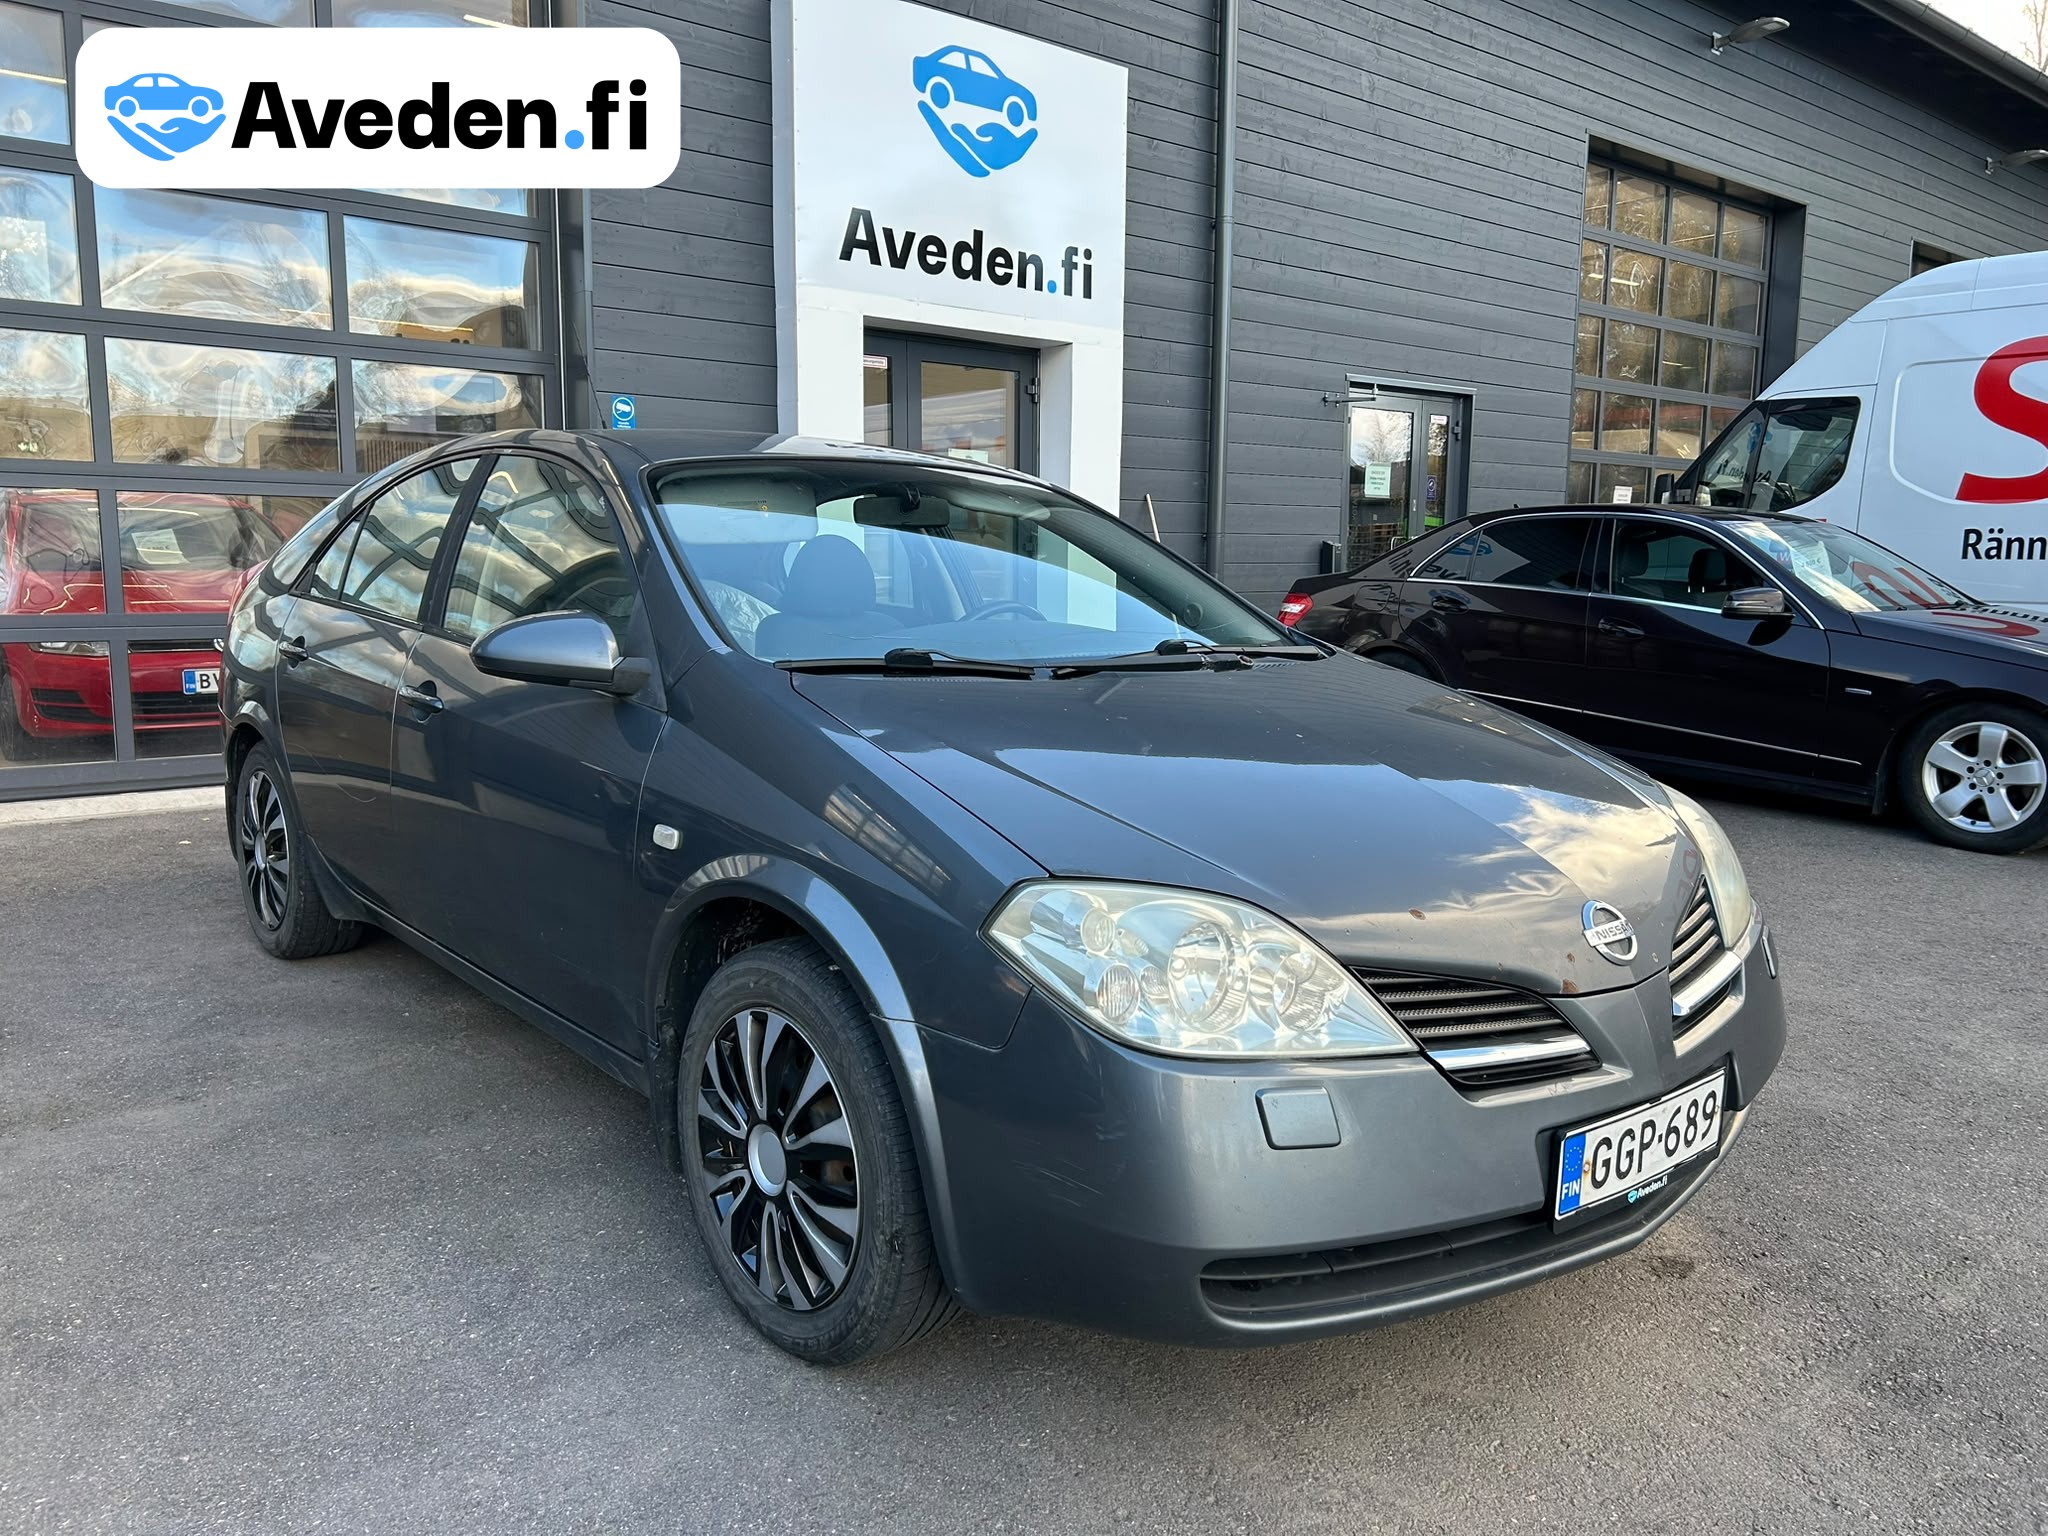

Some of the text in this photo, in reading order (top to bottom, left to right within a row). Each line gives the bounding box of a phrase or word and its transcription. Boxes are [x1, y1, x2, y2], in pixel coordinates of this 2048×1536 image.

[838, 206, 1093, 300] Aveden.fi
[1954, 335, 2048, 504] S
[1590, 1089, 1718, 1190] GGP-689
[1637, 1174, 1668, 1199] Aveden.fi
[1560, 1178, 1581, 1201] FIN
